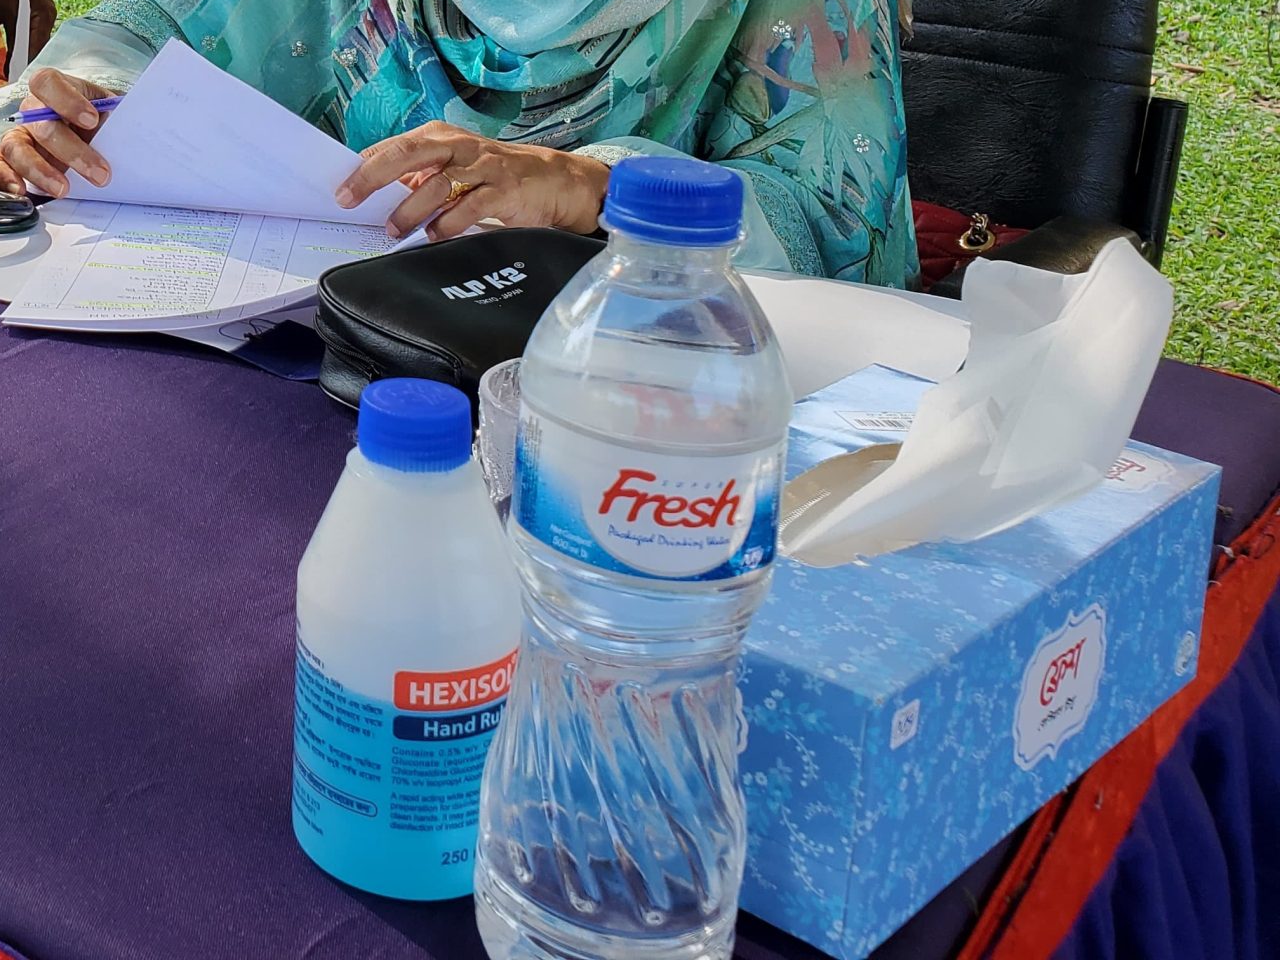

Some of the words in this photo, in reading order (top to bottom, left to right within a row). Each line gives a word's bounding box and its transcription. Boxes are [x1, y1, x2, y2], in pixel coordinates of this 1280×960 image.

[598, 468, 740, 528] Fresh
[423, 715, 477, 738] Hand
[391, 746, 434, 758] Contains
[391, 755, 440, 768] Gluconate
[440, 848, 469, 866] 250
